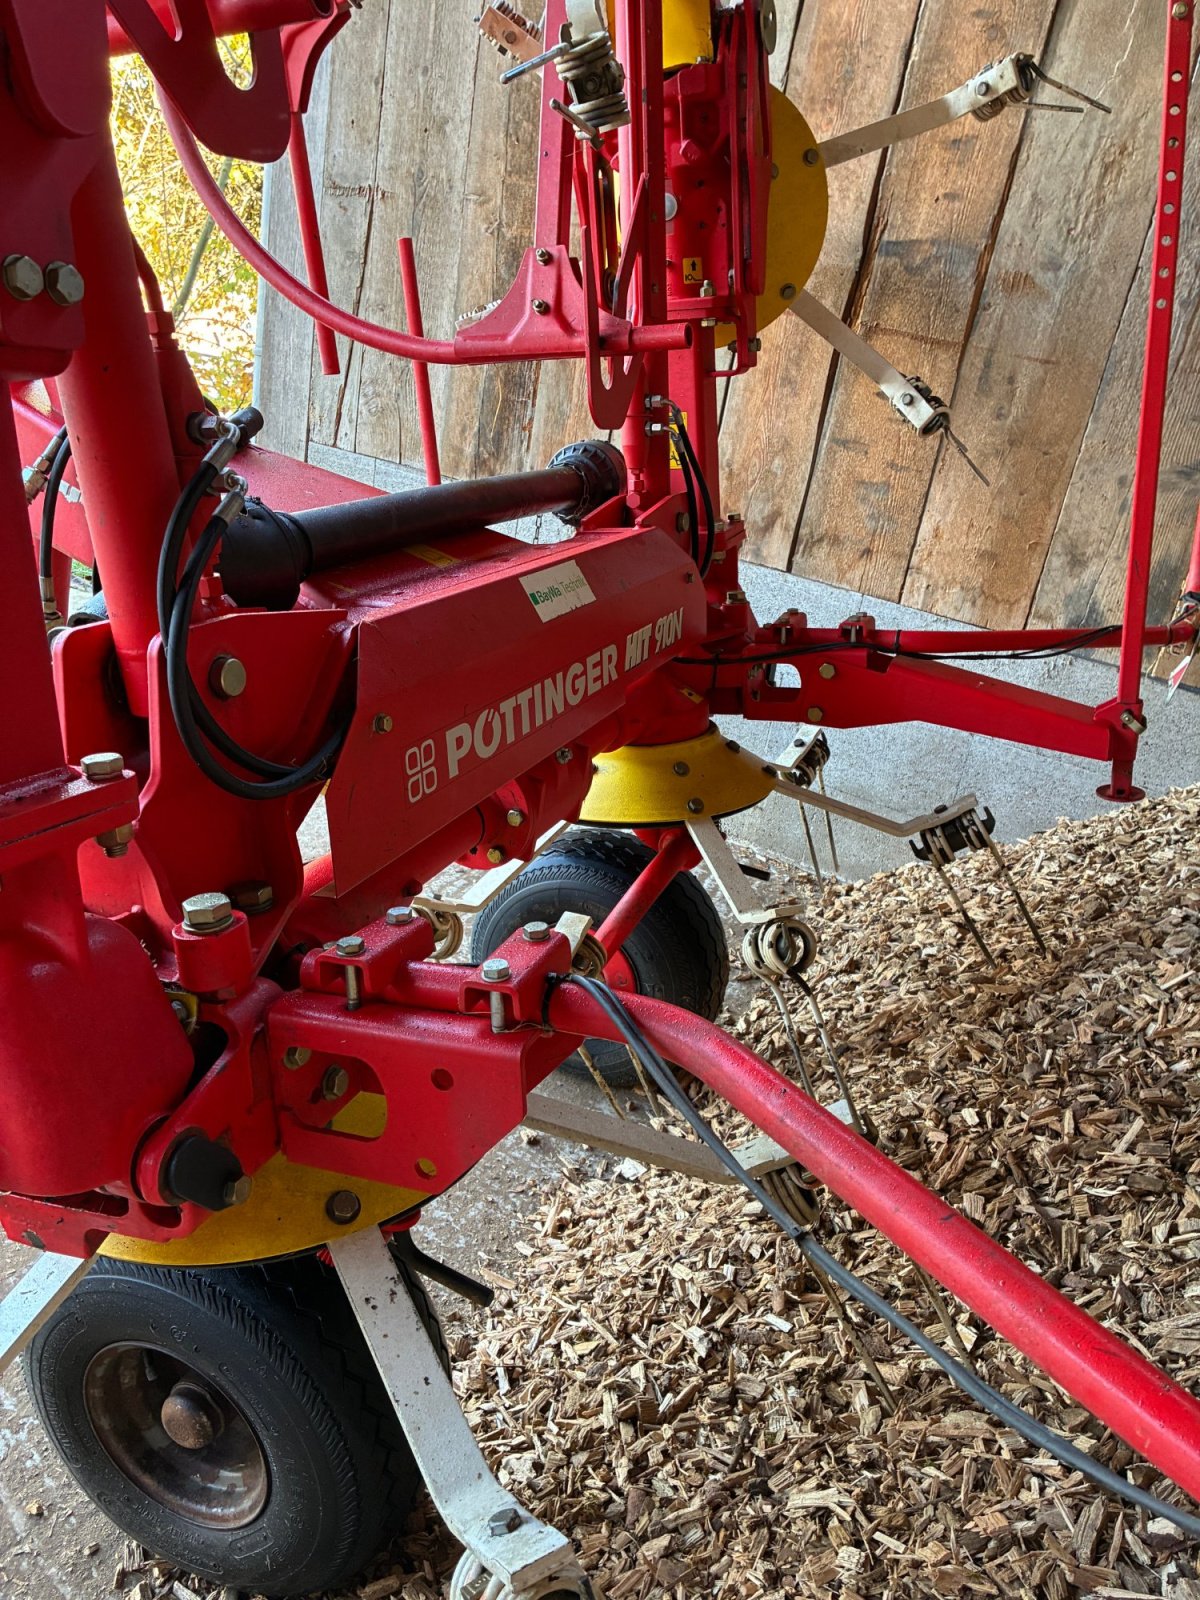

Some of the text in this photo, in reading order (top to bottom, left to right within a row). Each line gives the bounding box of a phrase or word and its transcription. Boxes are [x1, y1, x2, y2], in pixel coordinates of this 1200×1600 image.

[536, 586, 562, 604] BayWa
[445, 607, 684, 779] PÖTTINGER HIT 910N
